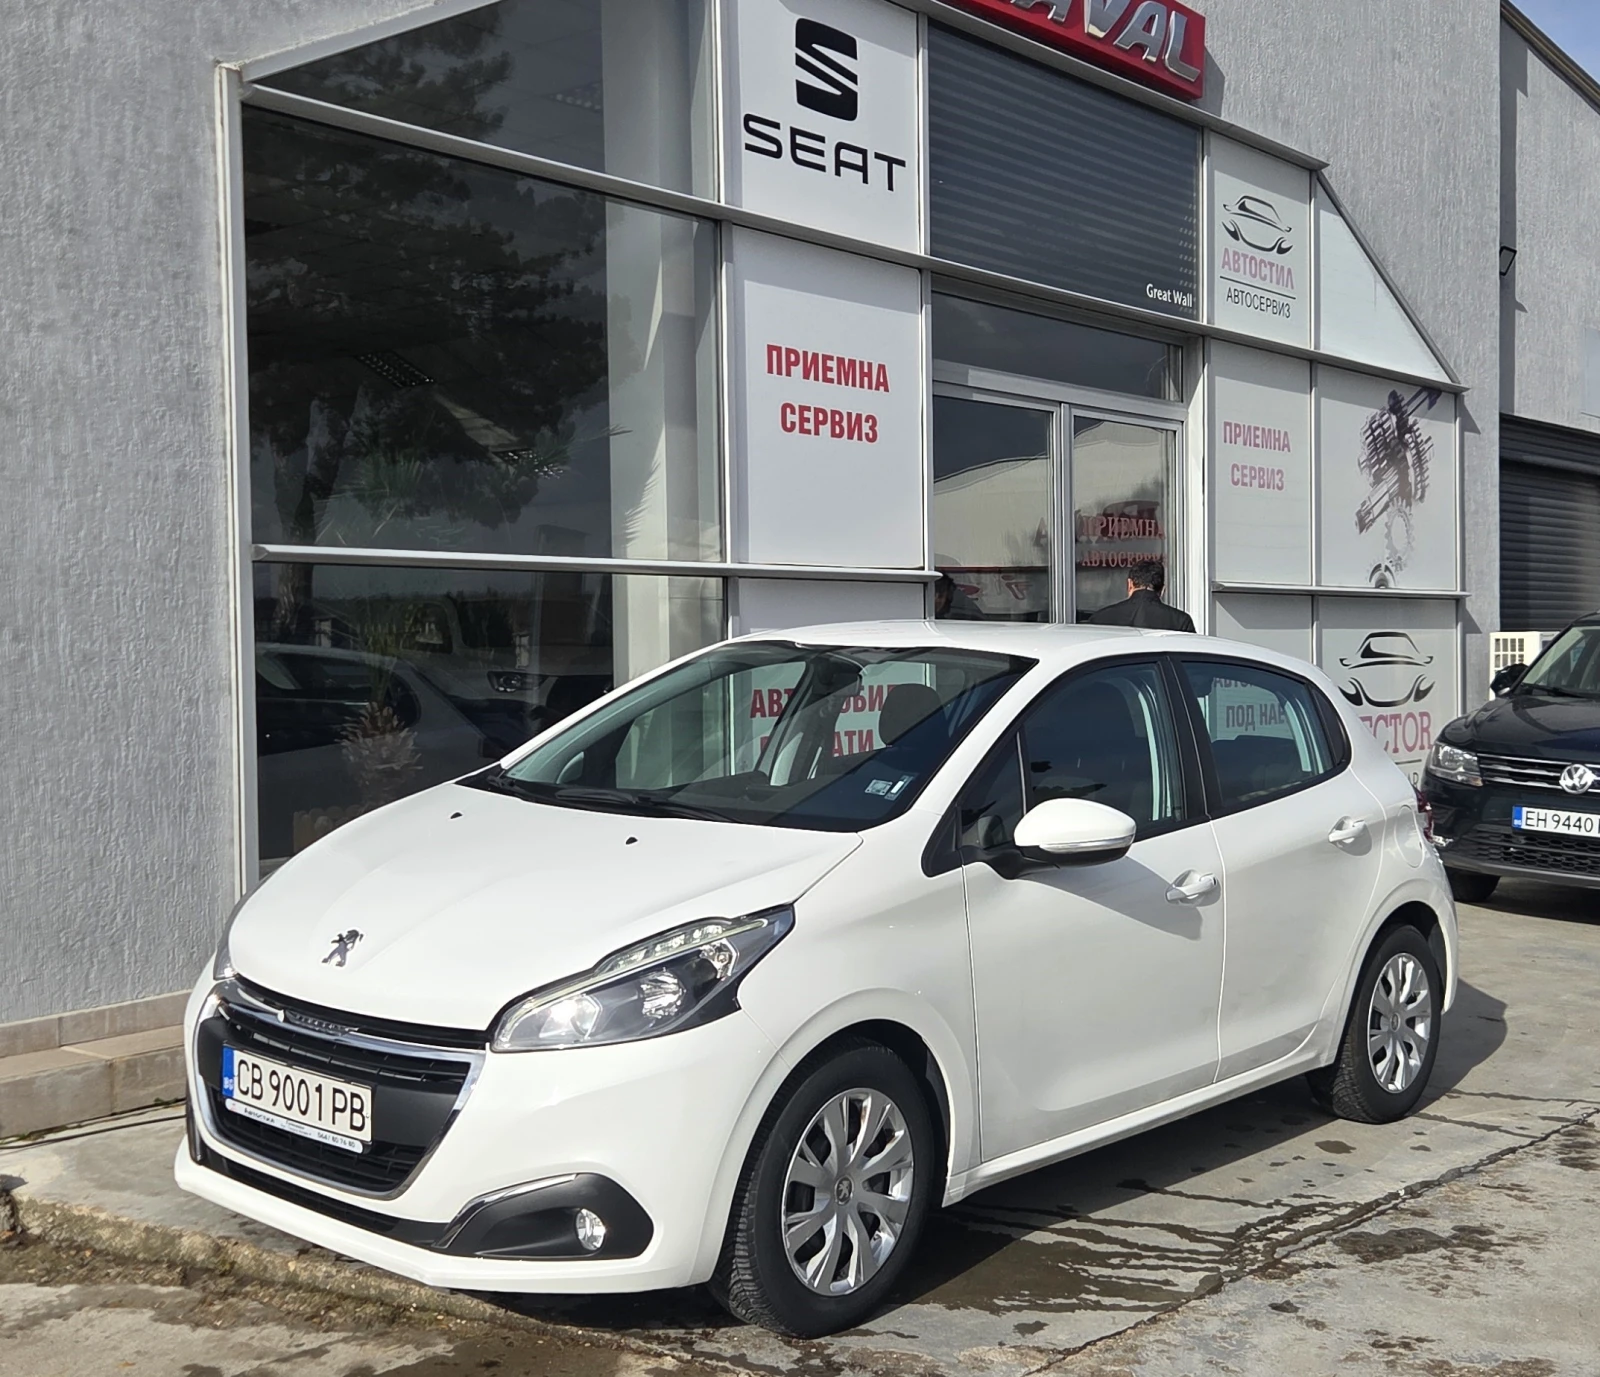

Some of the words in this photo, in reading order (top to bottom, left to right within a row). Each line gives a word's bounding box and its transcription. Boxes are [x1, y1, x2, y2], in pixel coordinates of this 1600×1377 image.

[743, 113, 906, 192] SEAT
[1221, 247, 1294, 290] АВТОСТИЛ
[1146, 283, 1171, 303] Great
[1173, 289, 1193, 308] Wall
[1226, 286, 1291, 319] АВТОСЕРВИЗ
[766, 343, 890, 393] ПРИЕМНА
[780, 402, 879, 443] СЕРВИЗ
[1223, 421, 1291, 453] ПРИЕМНА
[1230, 463, 1285, 491] СЕРВИЗ
[1081, 514, 1166, 540] ПРИЕМНА
[1226, 704, 1255, 732] ПОД
[1525, 810, 1547, 828] EH
[1551, 813, 1594, 833] 9440
[237, 1059, 263, 1101] CB
[269, 1069, 323, 1122] 9001
[332, 1086, 366, 1132] PB
